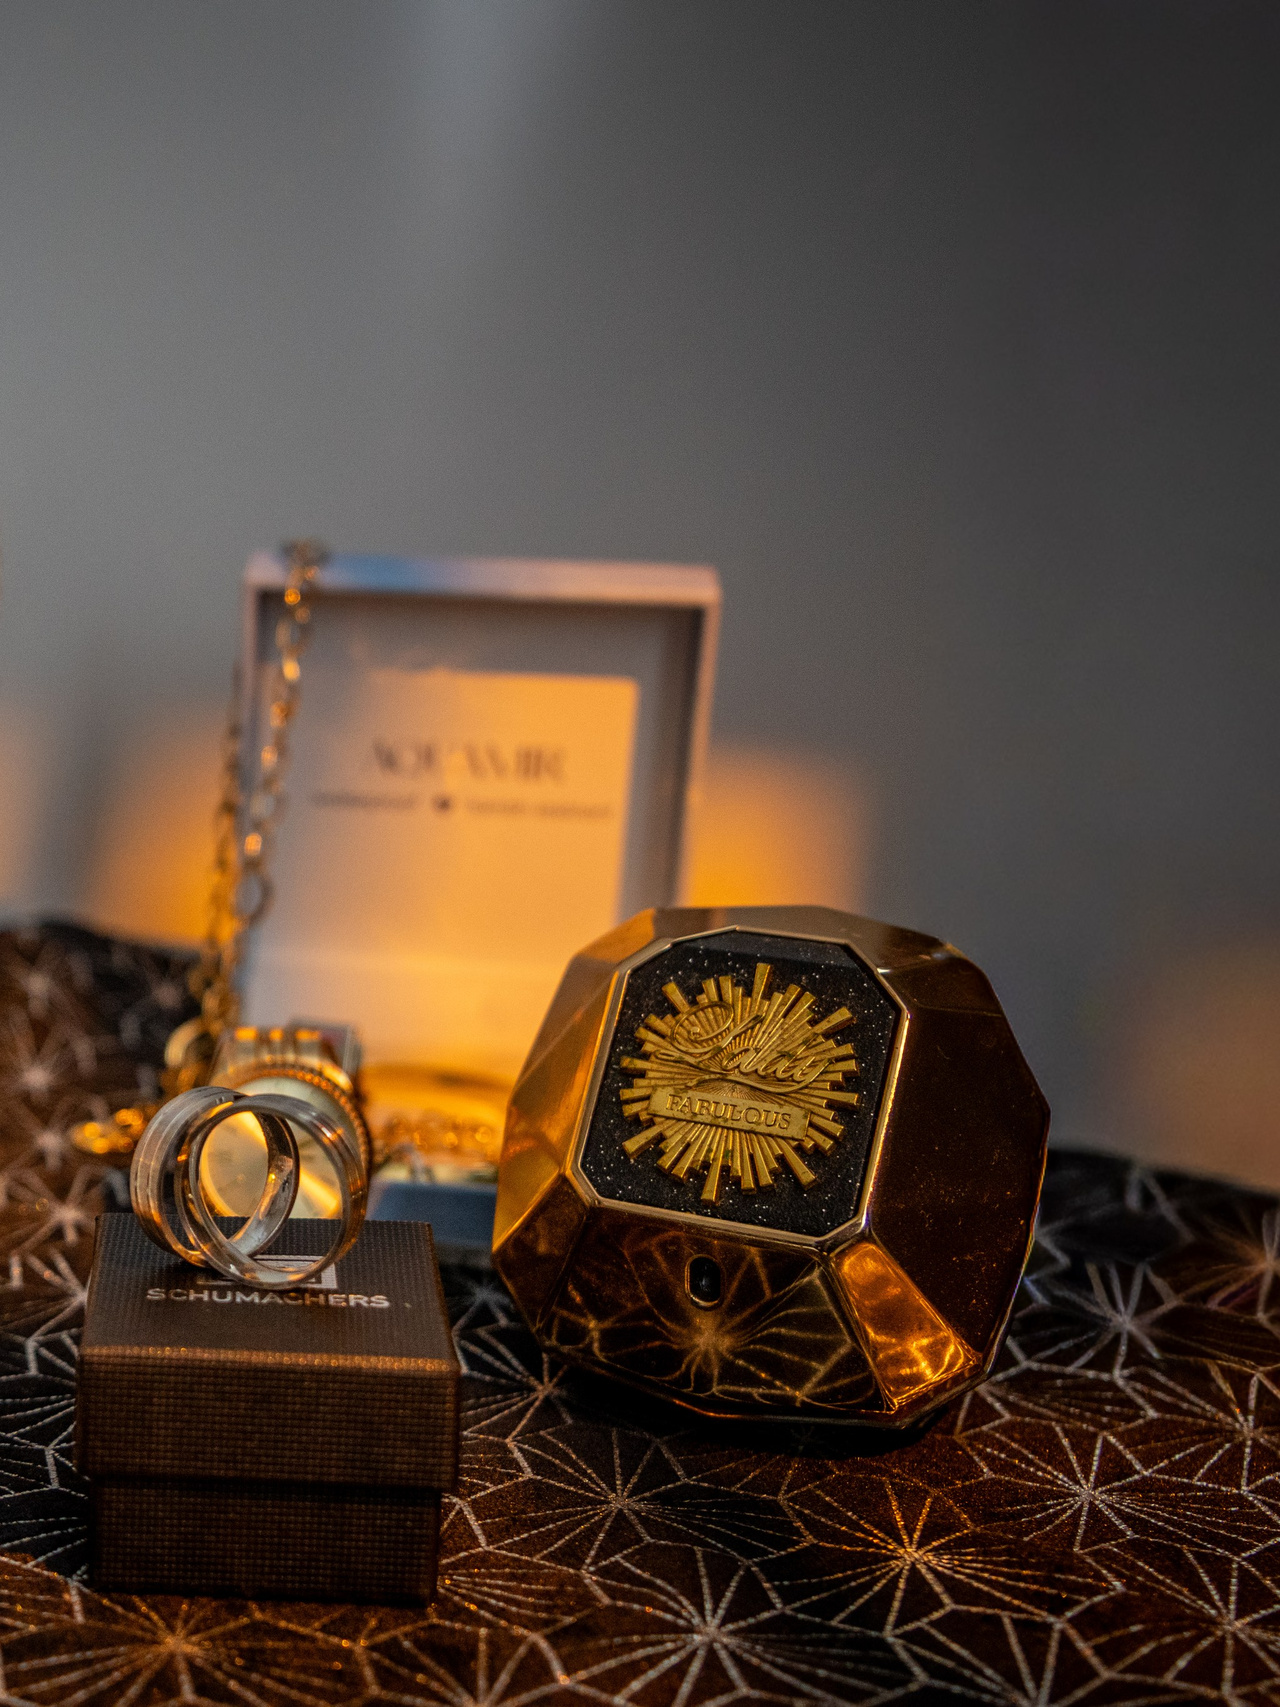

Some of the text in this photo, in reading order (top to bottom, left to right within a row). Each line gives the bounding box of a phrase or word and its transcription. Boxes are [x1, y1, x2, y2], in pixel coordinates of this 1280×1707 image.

[654, 1001, 835, 1093] Lady
[665, 1093, 792, 1130] FABULOUS
[145, 1287, 391, 1309] SCHUMACHERS
